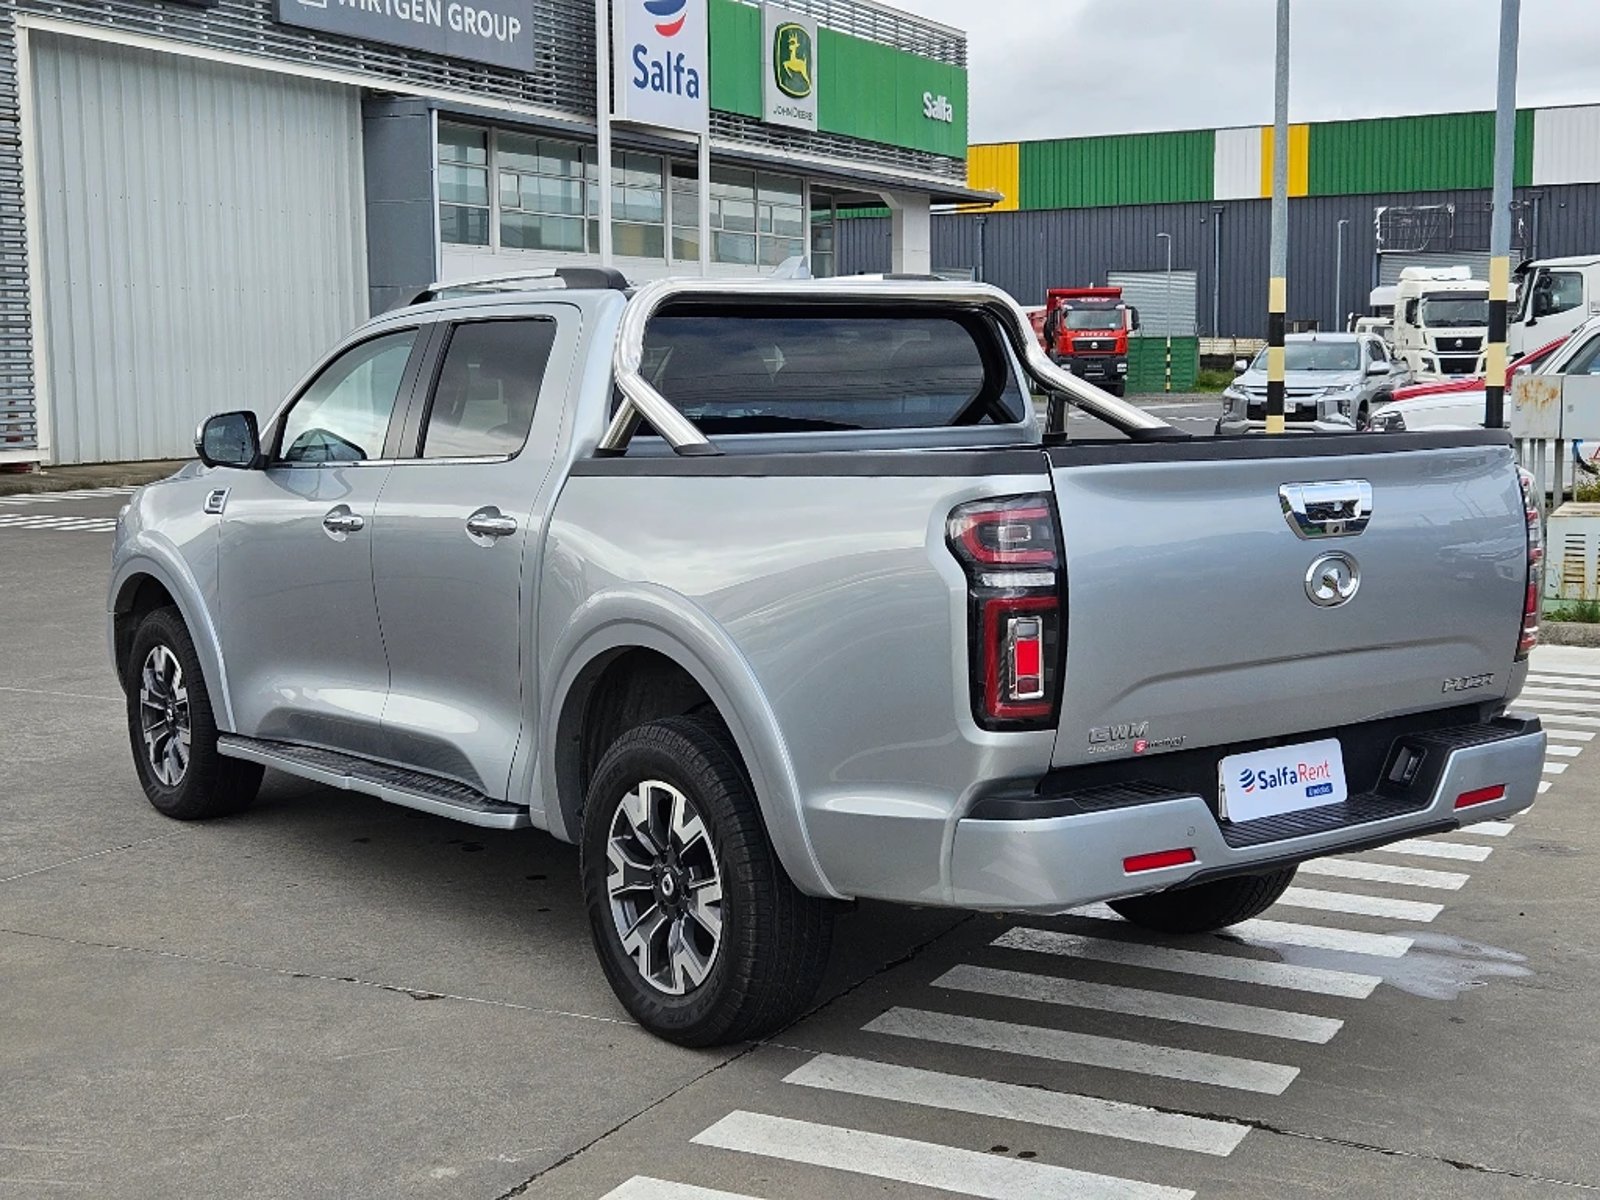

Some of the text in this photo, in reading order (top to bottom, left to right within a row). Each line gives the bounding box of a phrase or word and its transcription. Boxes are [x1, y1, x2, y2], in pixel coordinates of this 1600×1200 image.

[338, 0, 521, 43] TGEN GROUP
[632, 43, 700, 99] Salfa
[922, 91, 953, 123] Salfa
[1088, 721, 1149, 744] GWM
[1257, 761, 1331, 790] SalfaRent
